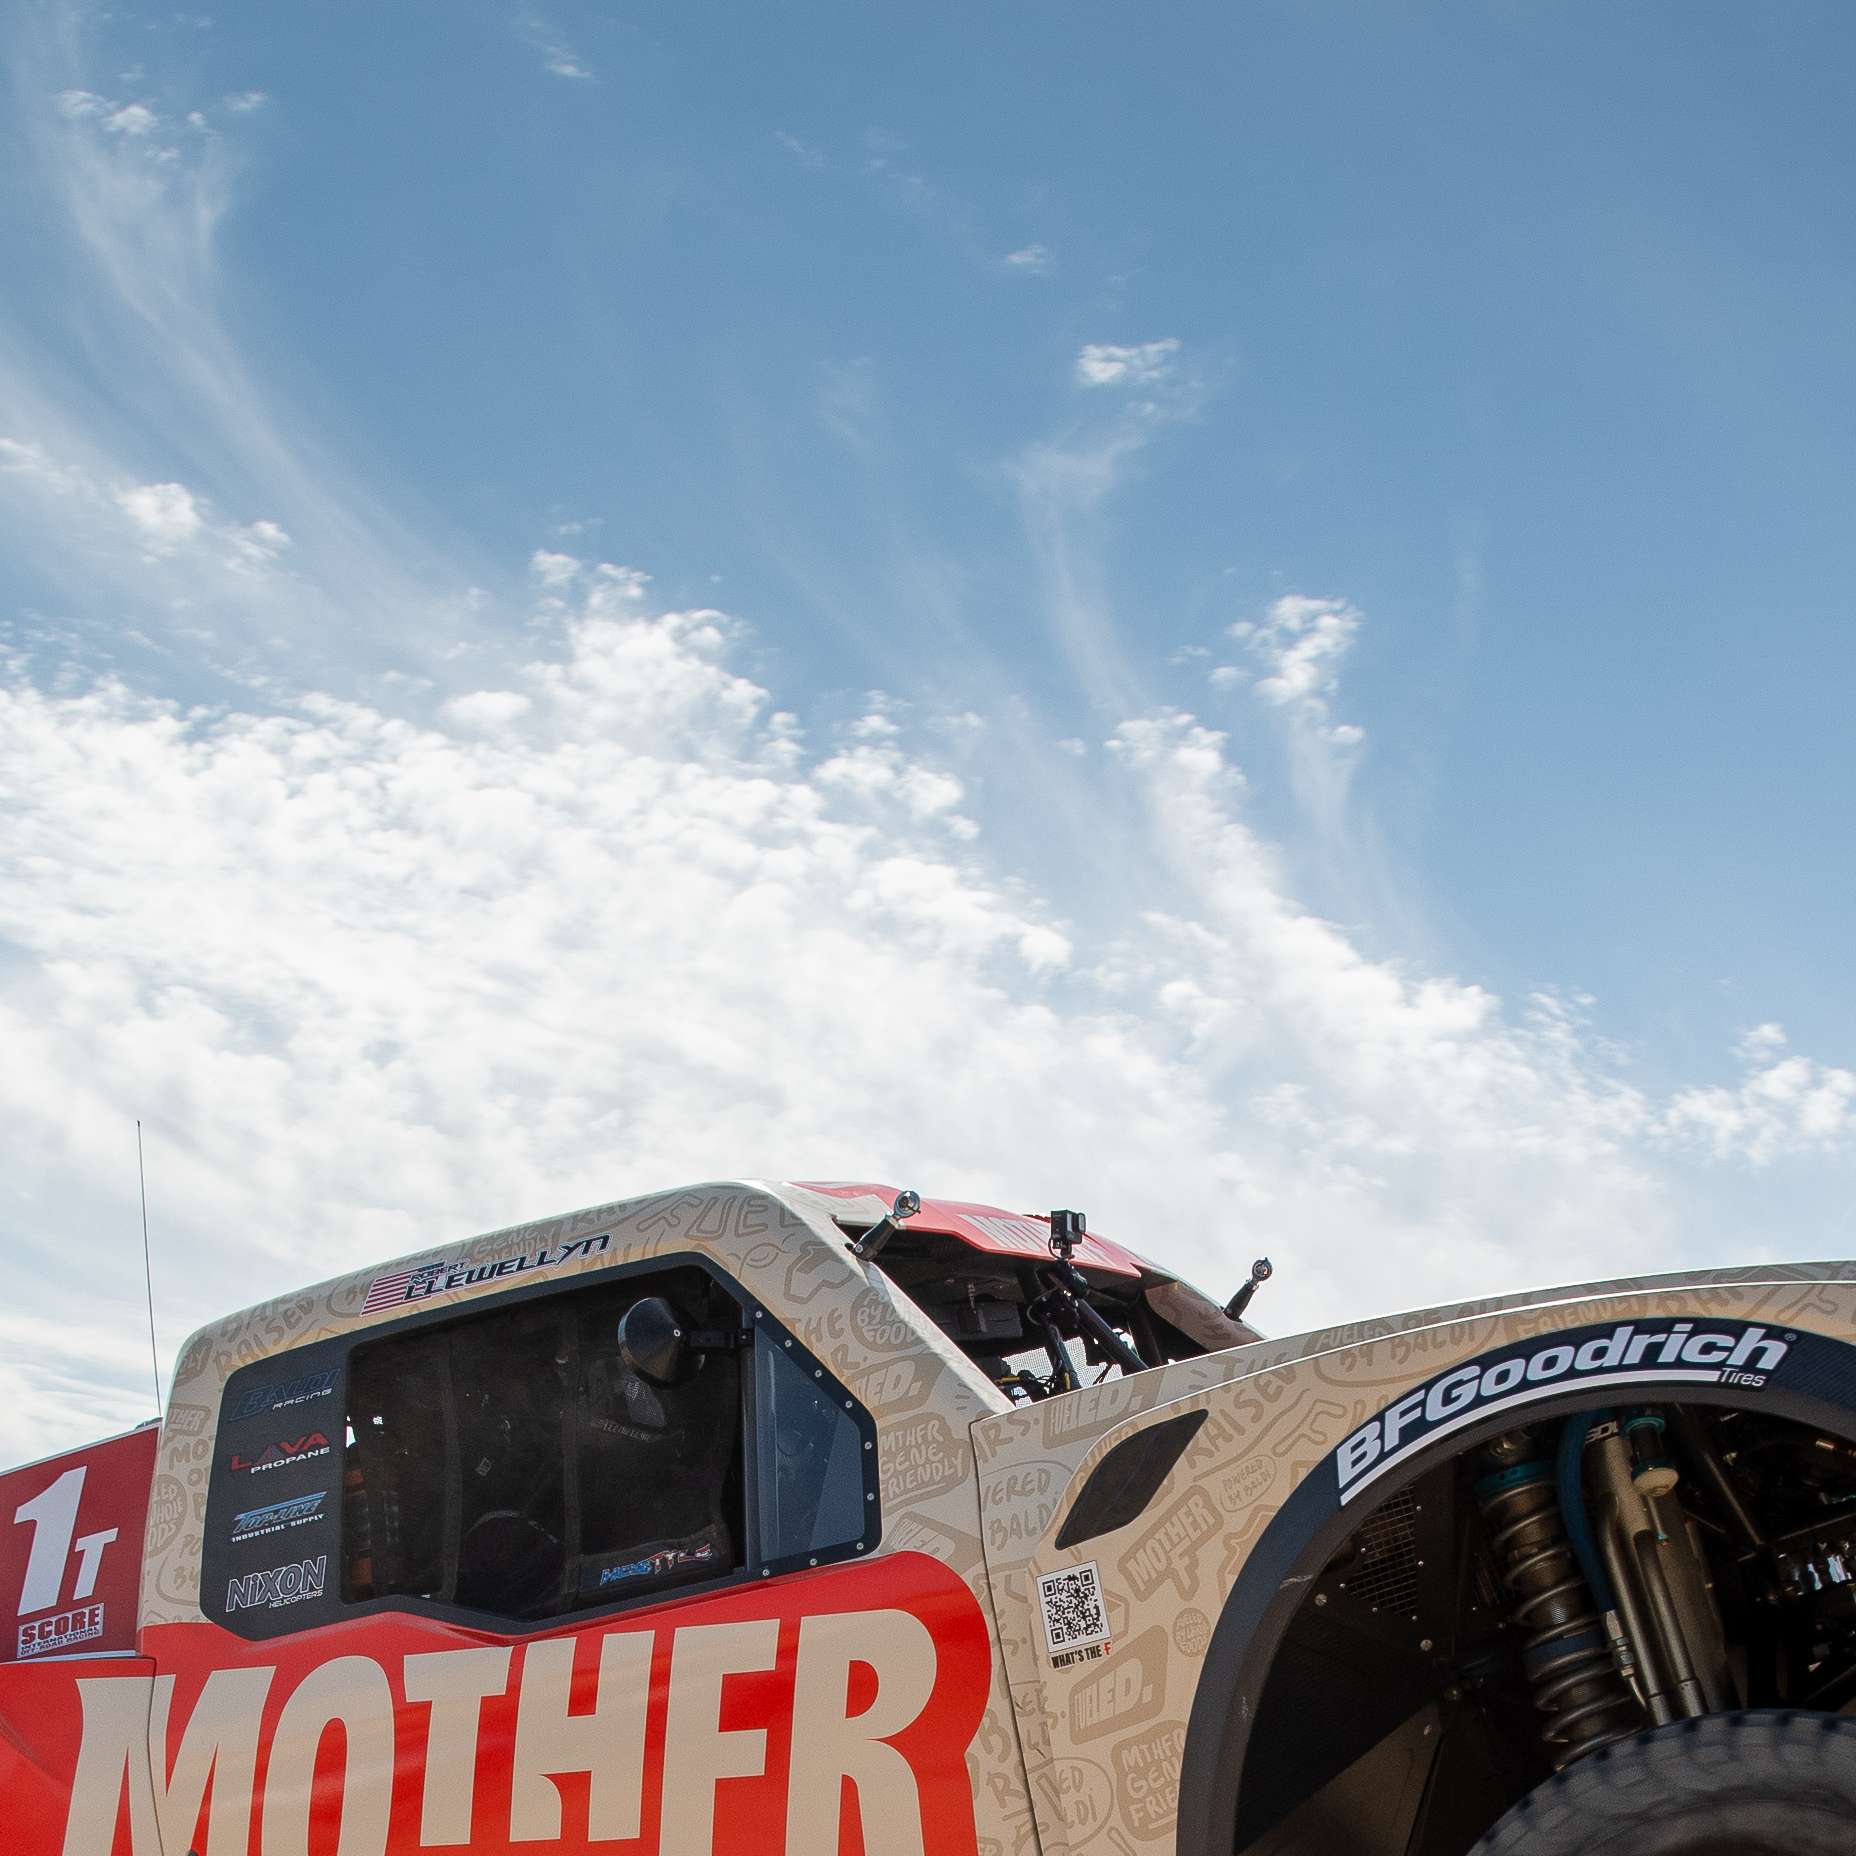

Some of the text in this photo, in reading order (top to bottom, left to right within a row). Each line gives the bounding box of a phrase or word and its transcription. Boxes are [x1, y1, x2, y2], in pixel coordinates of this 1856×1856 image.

[403, 1234, 613, 1301] LLEWELLYN
[410, 1261, 465, 1281] ROBERT
[1718, 1367, 1767, 1388] Tires
[272, 1388, 333, 1410] RACING
[1336, 1323, 1789, 1490] BFGoodrich
[230, 1431, 330, 1472] LAVA
[250, 1446, 331, 1474] PROPANE
[231, 1513, 325, 1542] INDUSTRIAL SUPPLY
[268, 1589, 324, 1609] HELICOPTERS
[20, 1606, 100, 1646] SCORE
[1051, 1648, 1084, 1669] WHAT'S
[1085, 1645, 1102, 1662] THE
